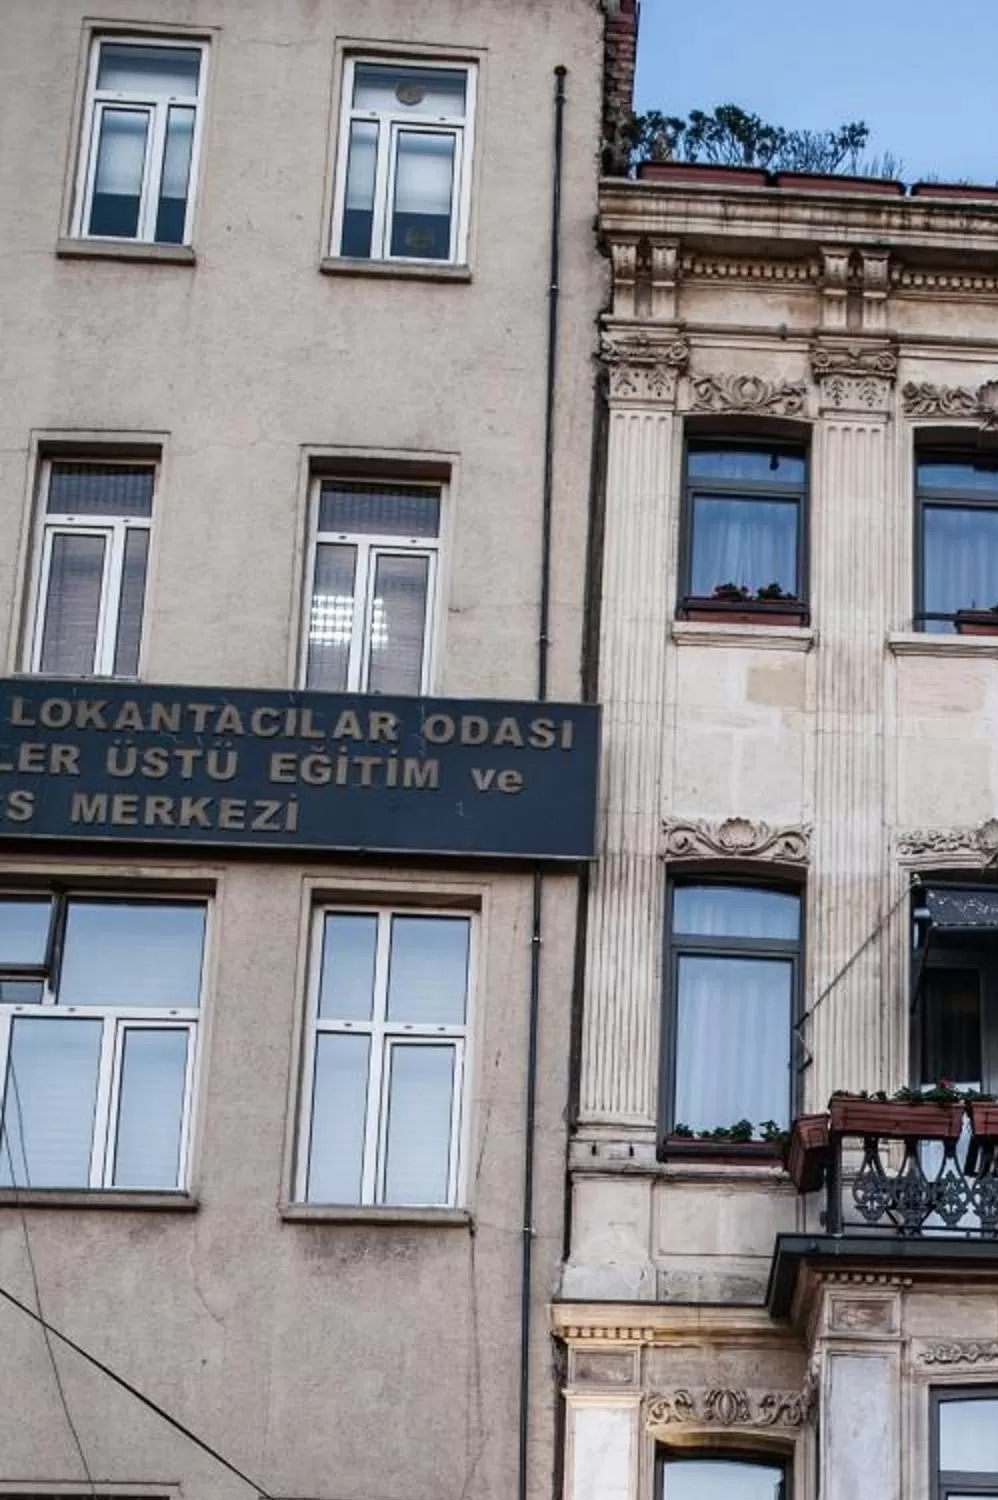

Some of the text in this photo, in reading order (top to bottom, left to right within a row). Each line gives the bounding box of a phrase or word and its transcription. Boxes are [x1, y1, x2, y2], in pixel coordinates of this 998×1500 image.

[10, 696, 574, 750] LOKANTACILAR ODASI
[106, 739, 239, 782] ÜSTÜ
[269, 745, 441, 791] EĞİTİM
[470, 765, 524, 793] ve
[70, 792, 299, 833] MERKEZİ
